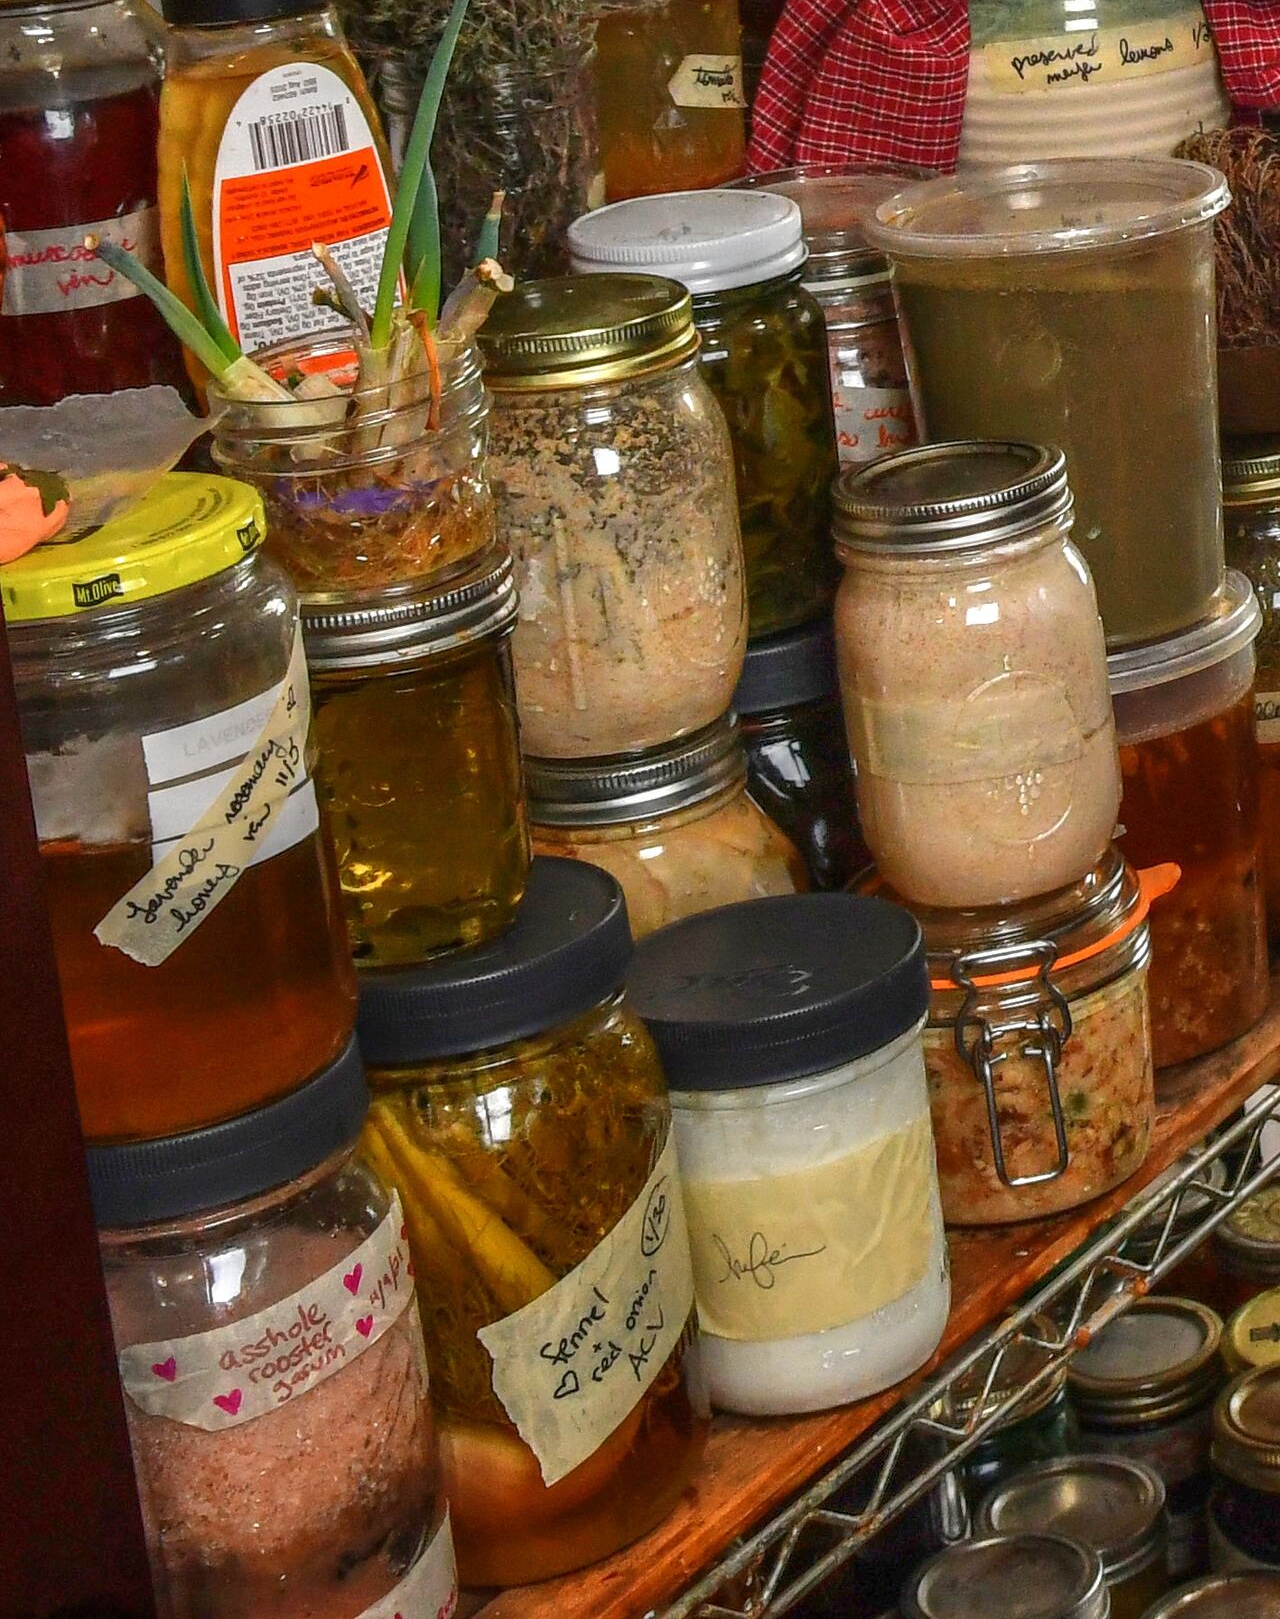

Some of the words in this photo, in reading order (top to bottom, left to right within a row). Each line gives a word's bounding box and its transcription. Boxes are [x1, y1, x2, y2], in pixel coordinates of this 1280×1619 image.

[1012, 32, 1099, 80] preserved
[1120, 38, 1173, 66] lemons
[170, 864, 239, 933] honey
[219, 1303, 326, 1371] asshole
[248, 1320, 331, 1384] rooster
[540, 1287, 609, 1366] fennel
[591, 1340, 622, 1382] red
[625, 1270, 657, 1331] onion
[628, 1302, 664, 1382] ACV
[272, 1343, 346, 1403] garum
